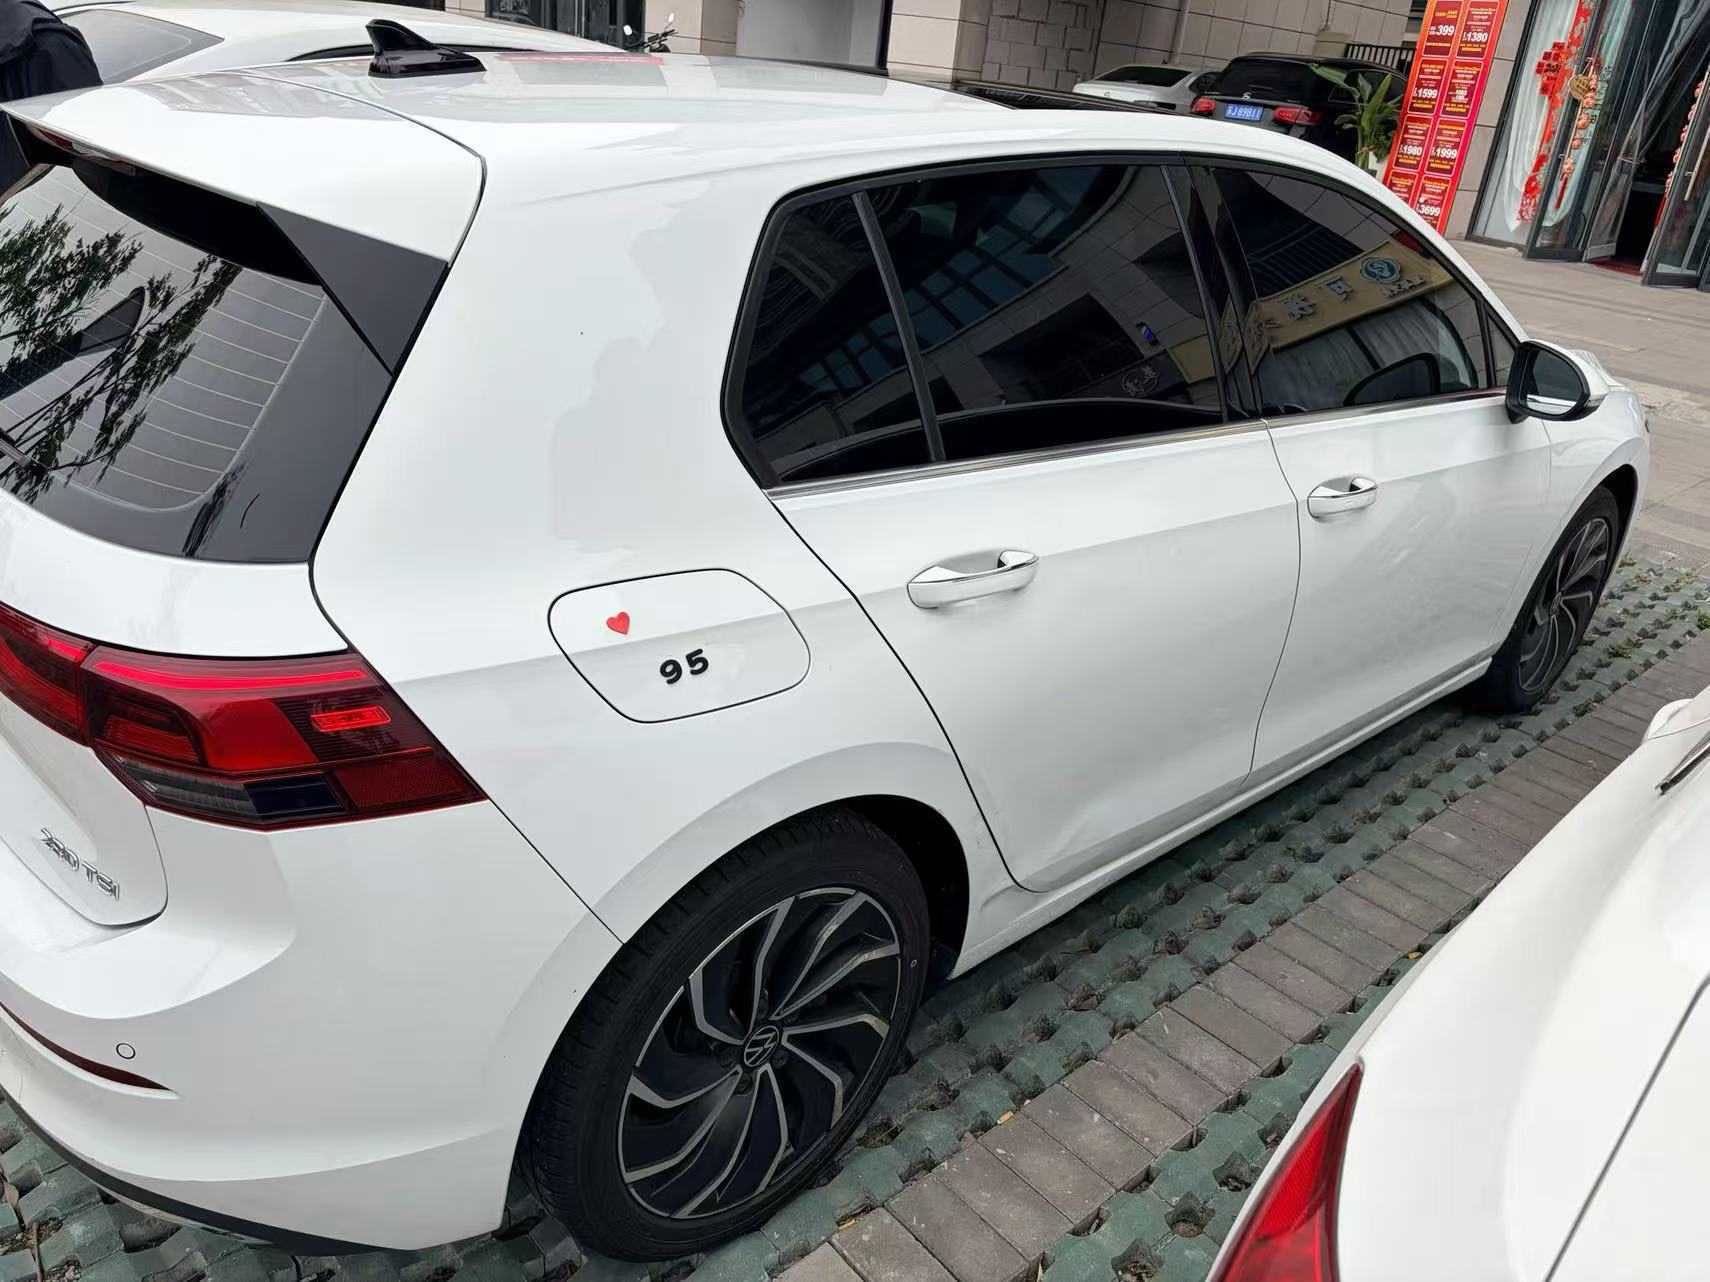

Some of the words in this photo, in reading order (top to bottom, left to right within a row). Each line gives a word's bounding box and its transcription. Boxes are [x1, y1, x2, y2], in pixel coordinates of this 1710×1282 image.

[1437, 25, 1455, 37] 399
[1436, 148, 1457, 159] 1999
[659, 648, 709, 685] 95
[82, 861, 120, 900] TSI
